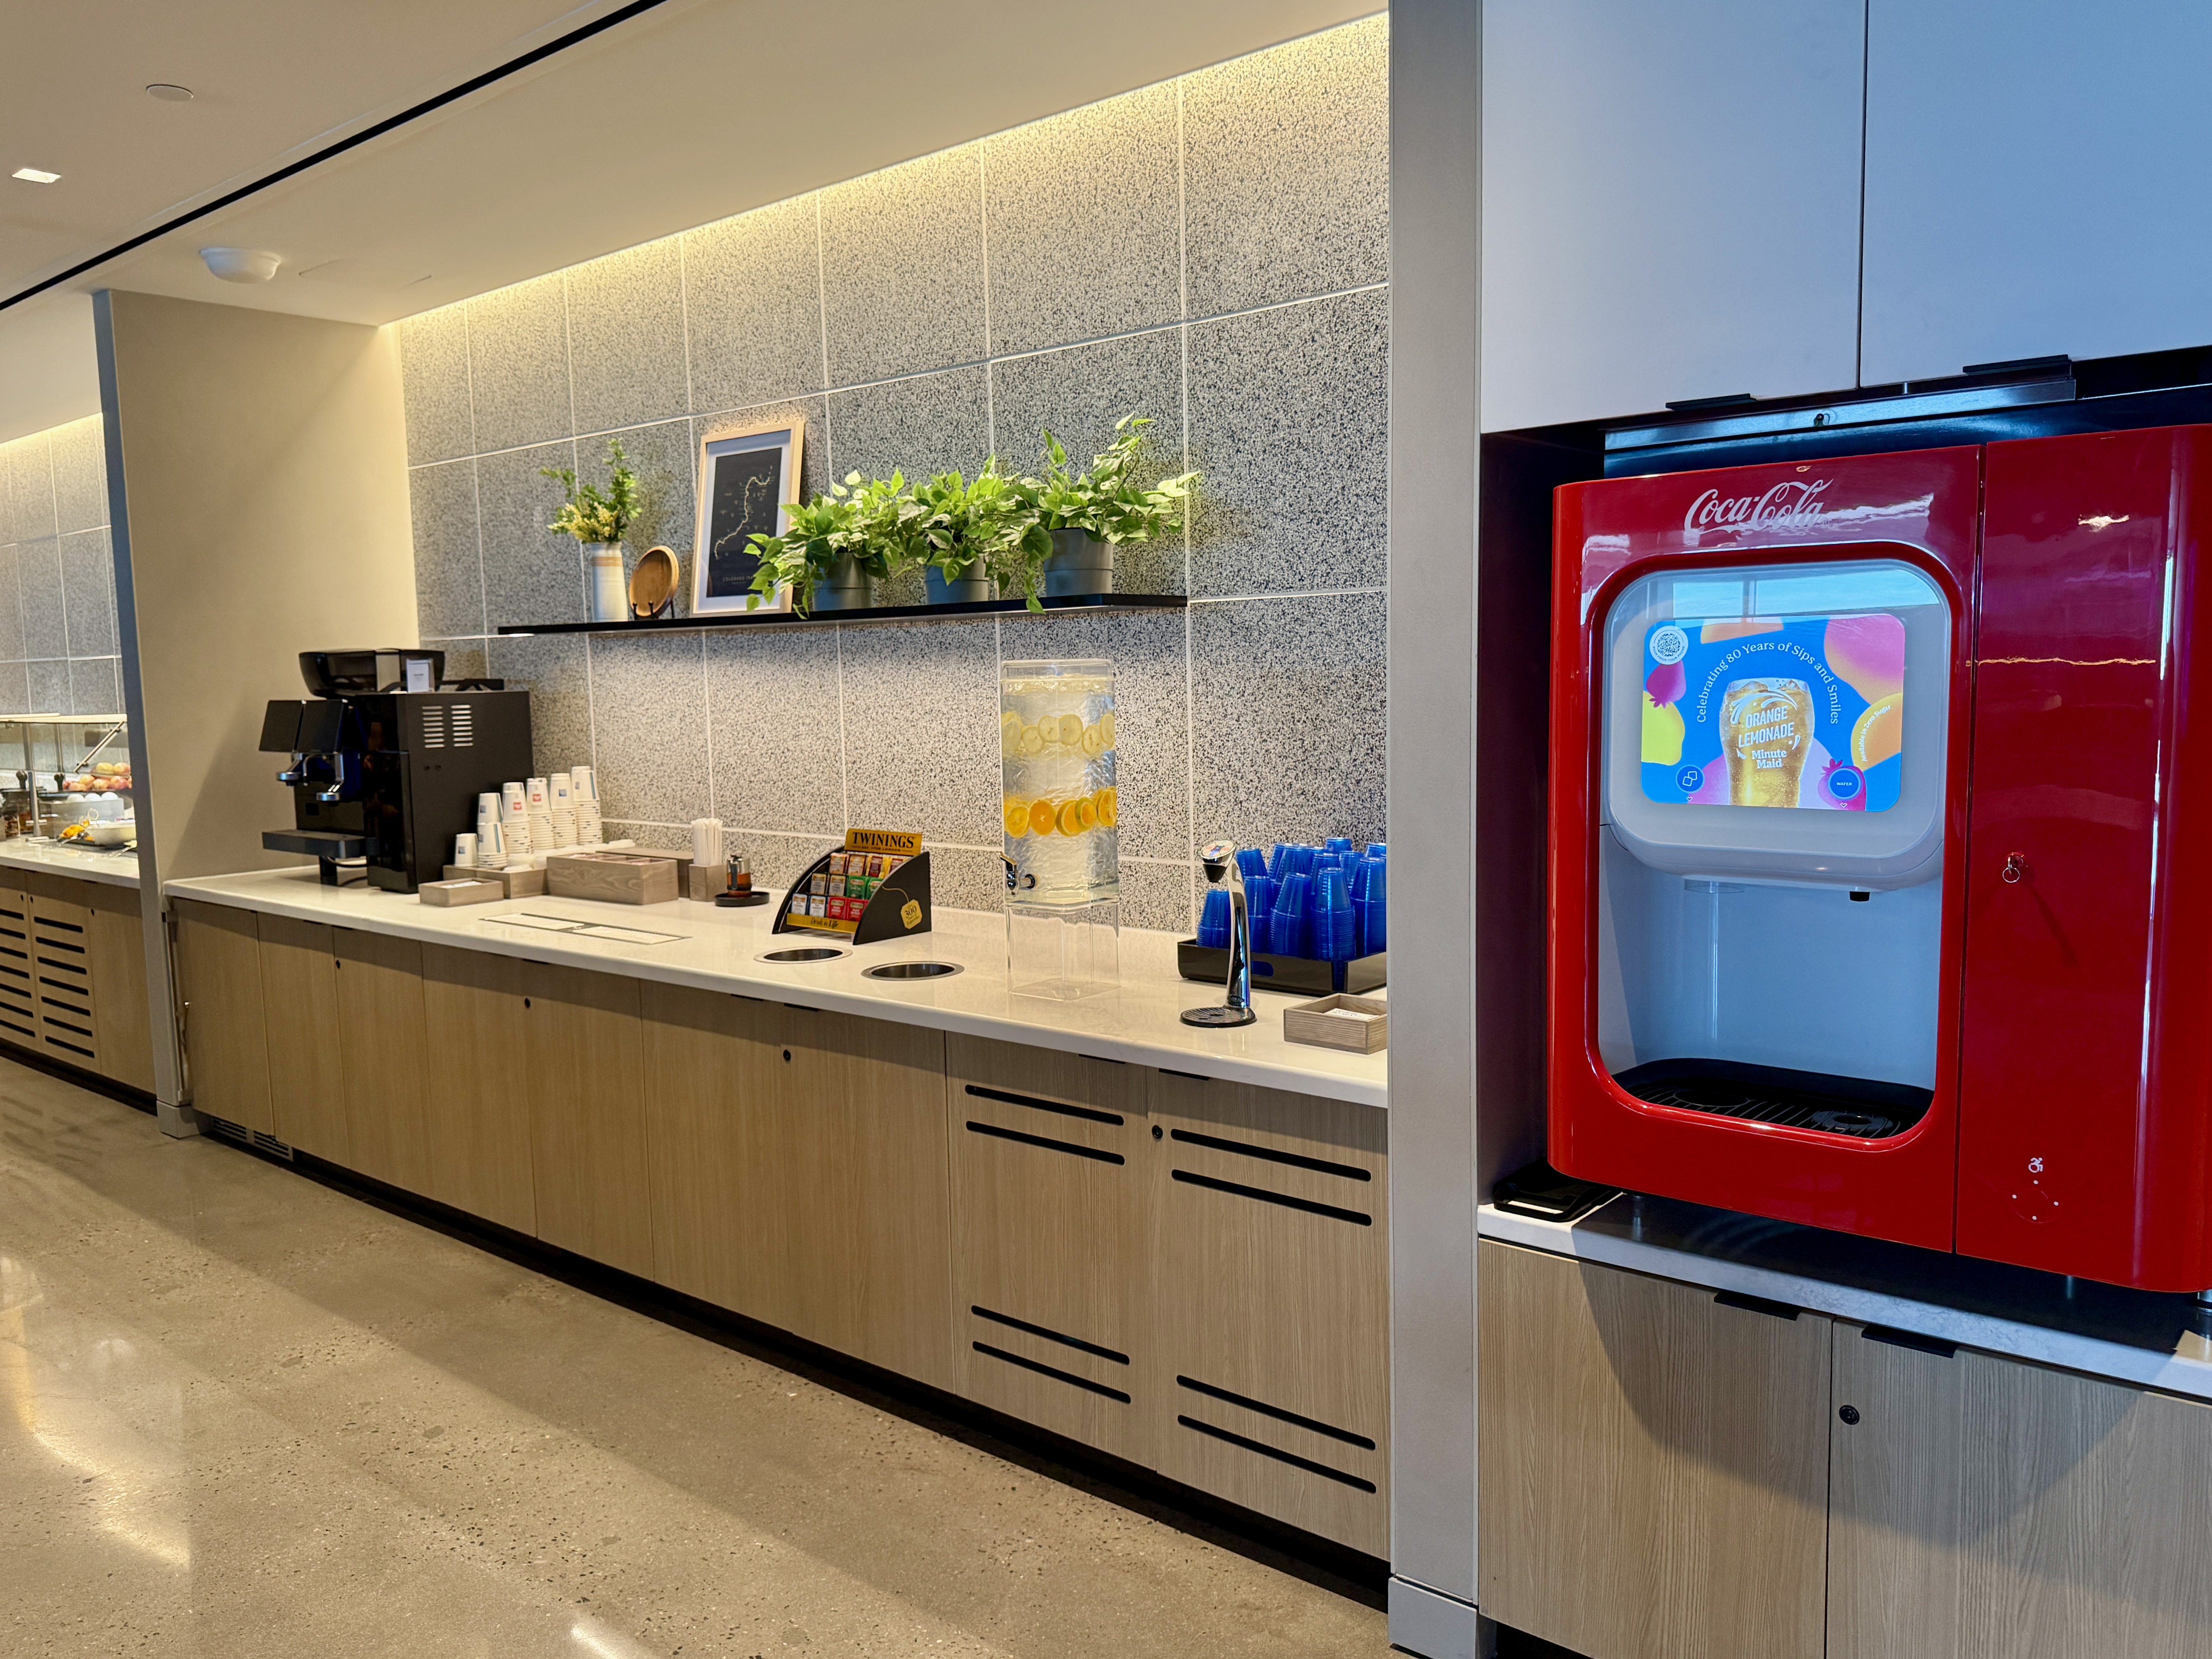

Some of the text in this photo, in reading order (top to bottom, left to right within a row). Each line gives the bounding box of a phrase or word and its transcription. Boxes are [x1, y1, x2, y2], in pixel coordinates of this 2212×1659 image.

[1684, 478, 1834, 535] Coca-Cola
[1697, 642, 1841, 724] Celebrating 80 Years of Sips and Smiles
[1746, 705, 1788, 728] ORANGE
[1738, 722, 1795, 748] LEMONADE
[1751, 749, 1787, 759] Minute
[1757, 758, 1783, 769] Maid
[853, 832, 915, 848] TWININGS
[904, 905, 917, 918] 300
